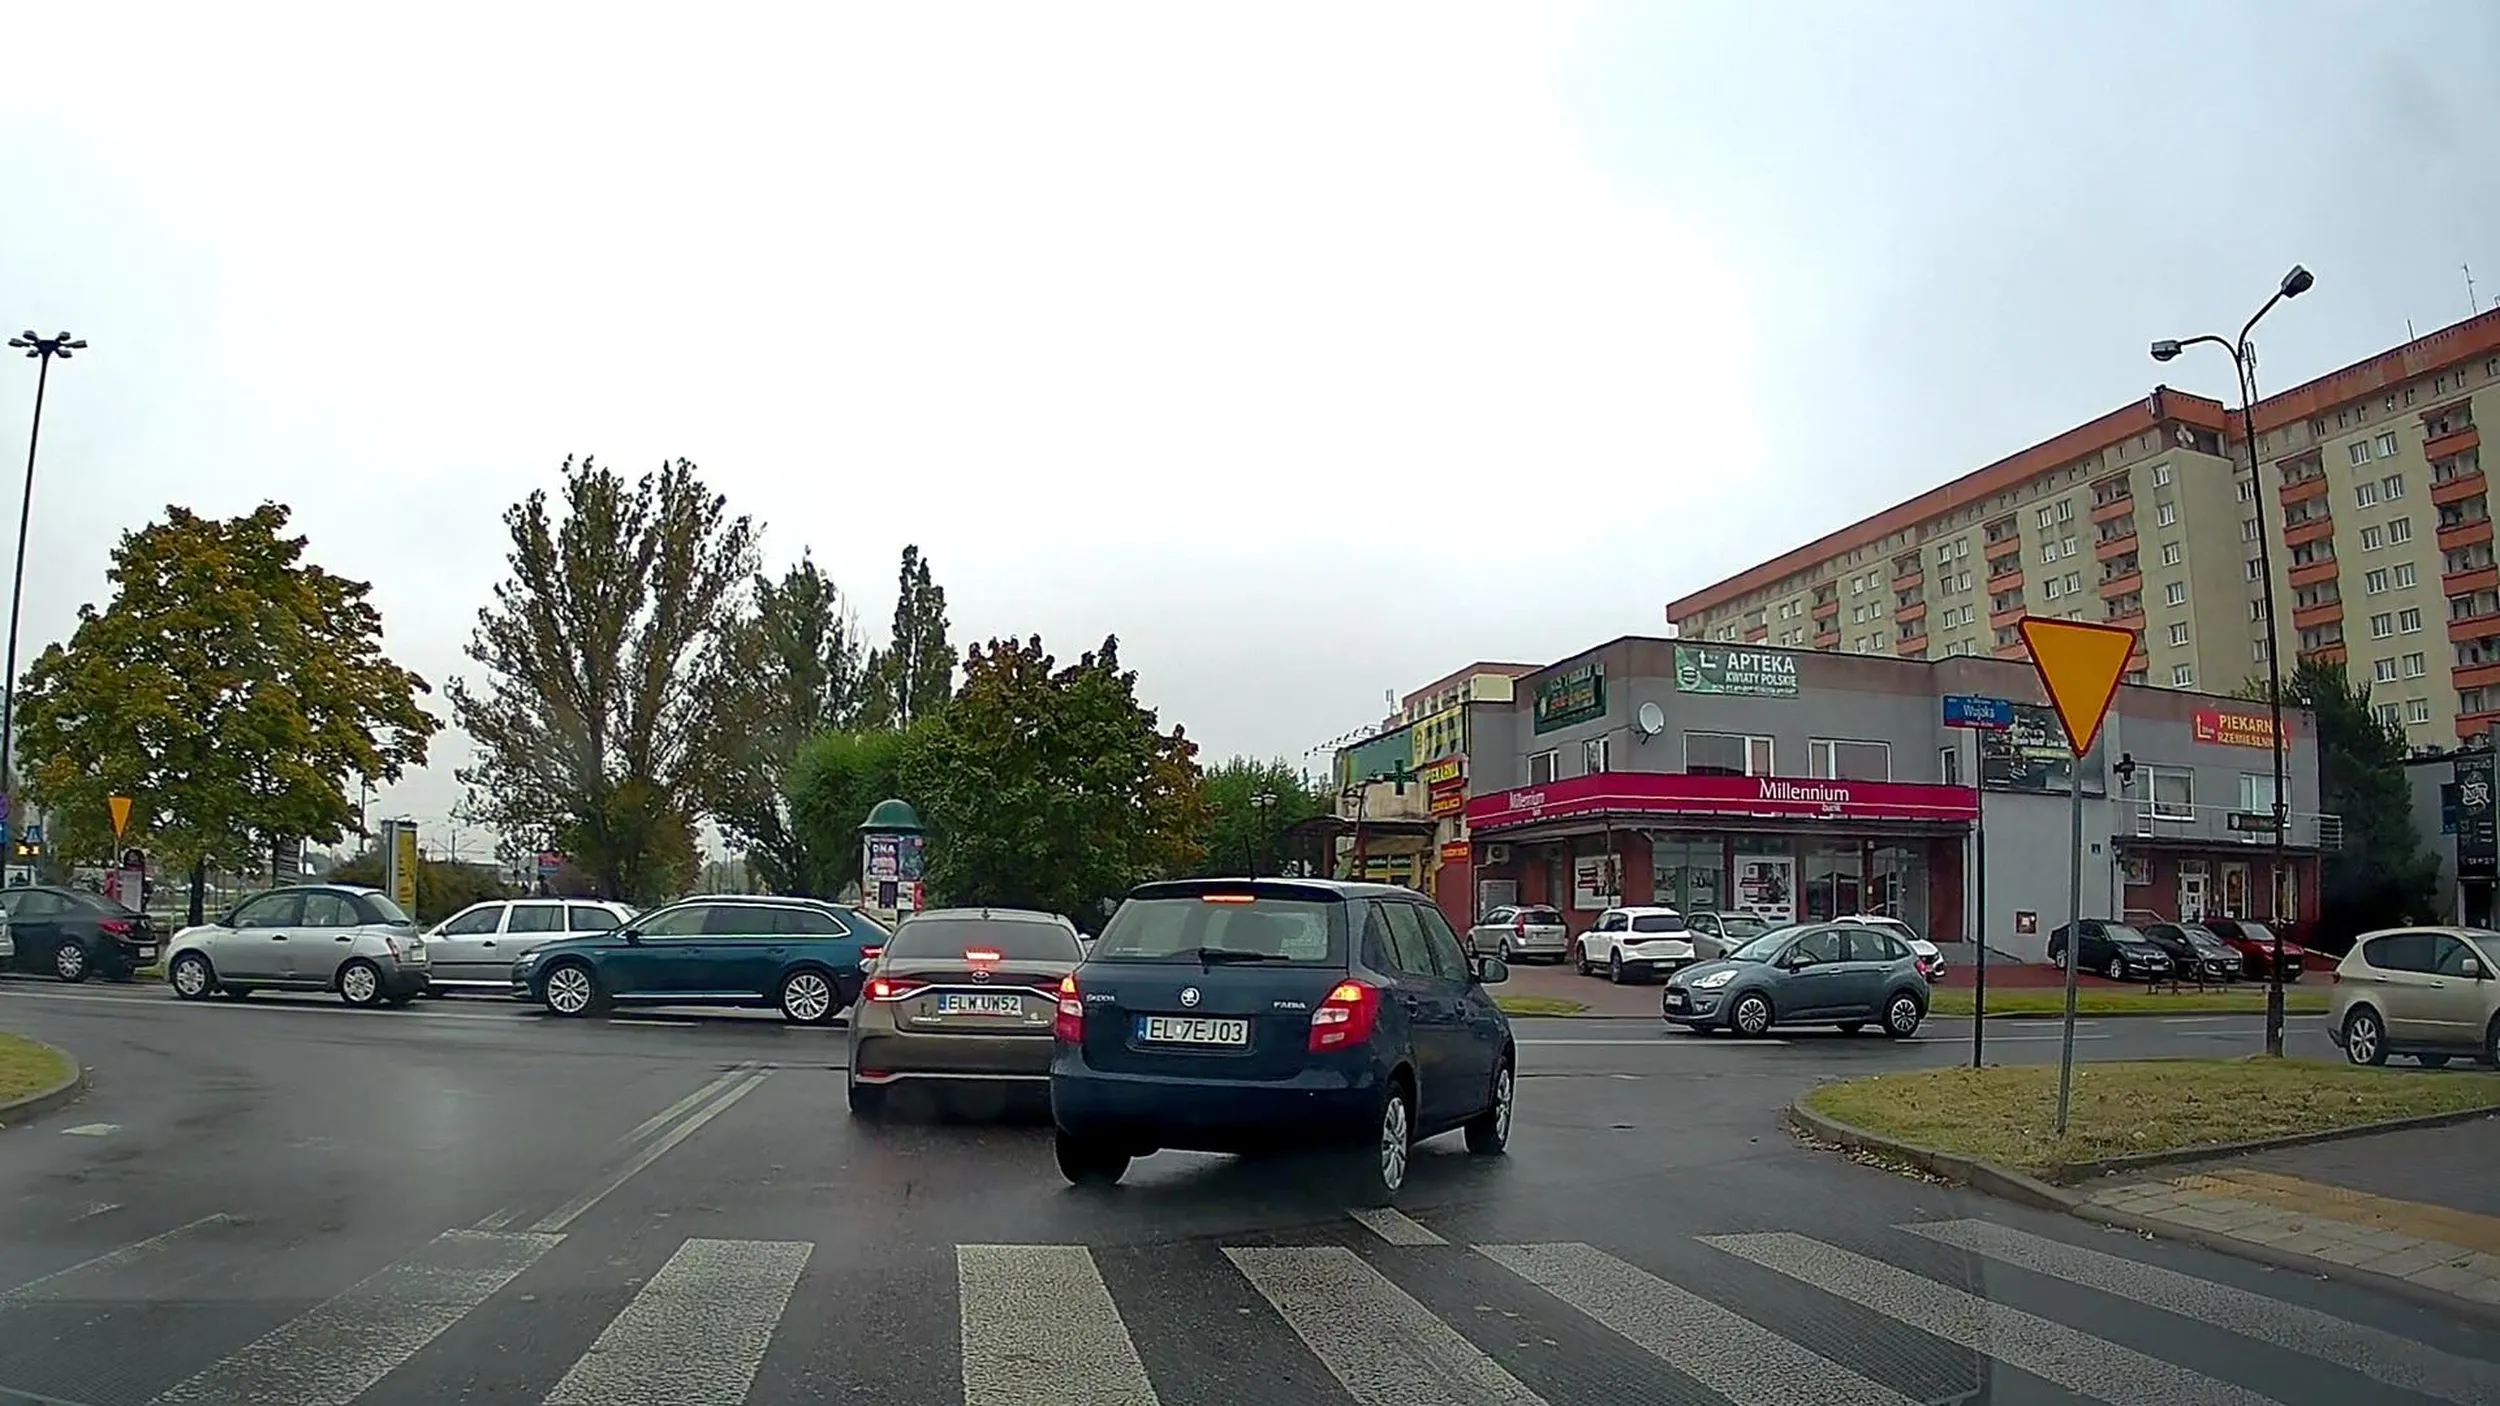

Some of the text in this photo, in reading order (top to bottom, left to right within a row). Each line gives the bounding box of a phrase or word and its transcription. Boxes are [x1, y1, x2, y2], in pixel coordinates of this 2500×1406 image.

[1727, 652, 1796, 673] APTEKA
[1725, 671, 1796, 687] KWIATY POLSKIE
[1759, 778, 1849, 801] Millennium
[1150, 1018, 1243, 1042] EL 7EJ03
